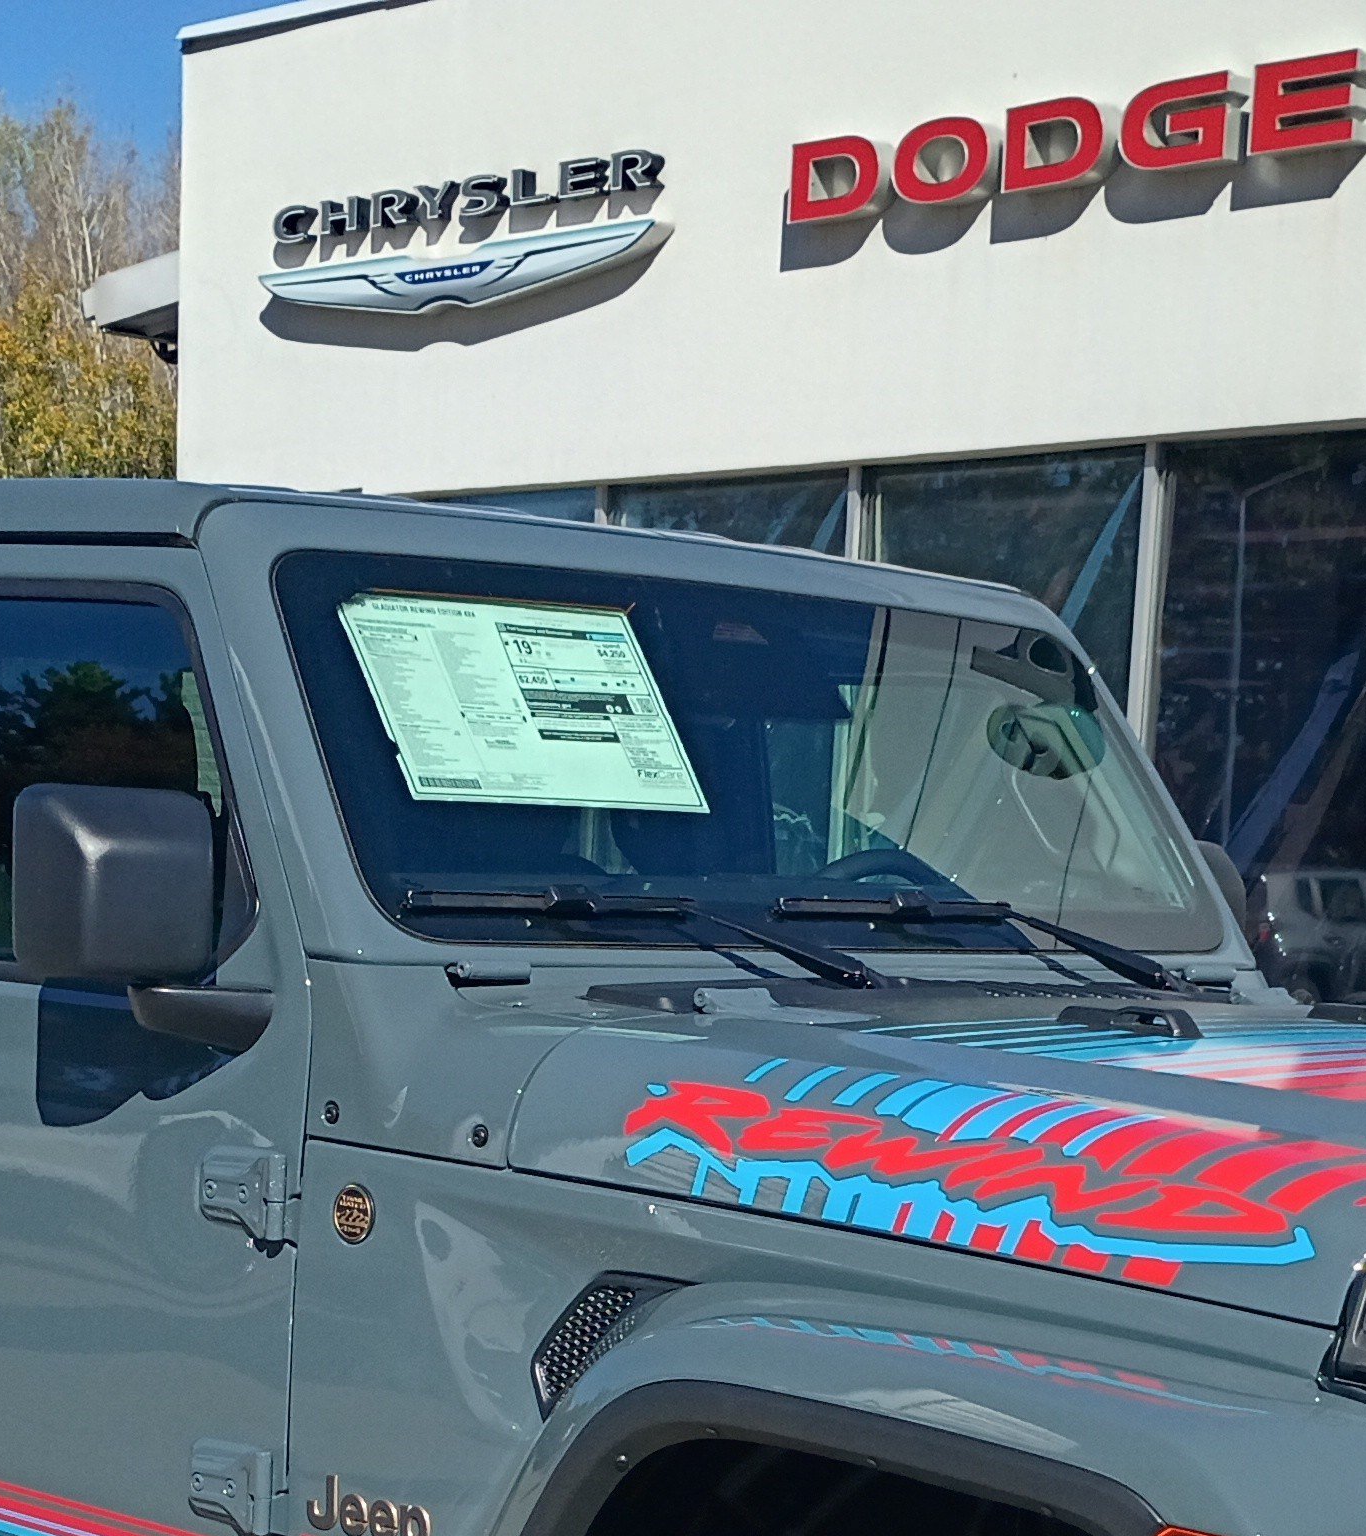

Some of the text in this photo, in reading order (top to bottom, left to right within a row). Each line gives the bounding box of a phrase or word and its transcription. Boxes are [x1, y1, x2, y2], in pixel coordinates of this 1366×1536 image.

[273, 148, 666, 244] CHRYSLER
[404, 264, 481, 282] CHRYSLER
[513, 639, 533, 655] 19
[638, 768, 684, 779] FlexCare
